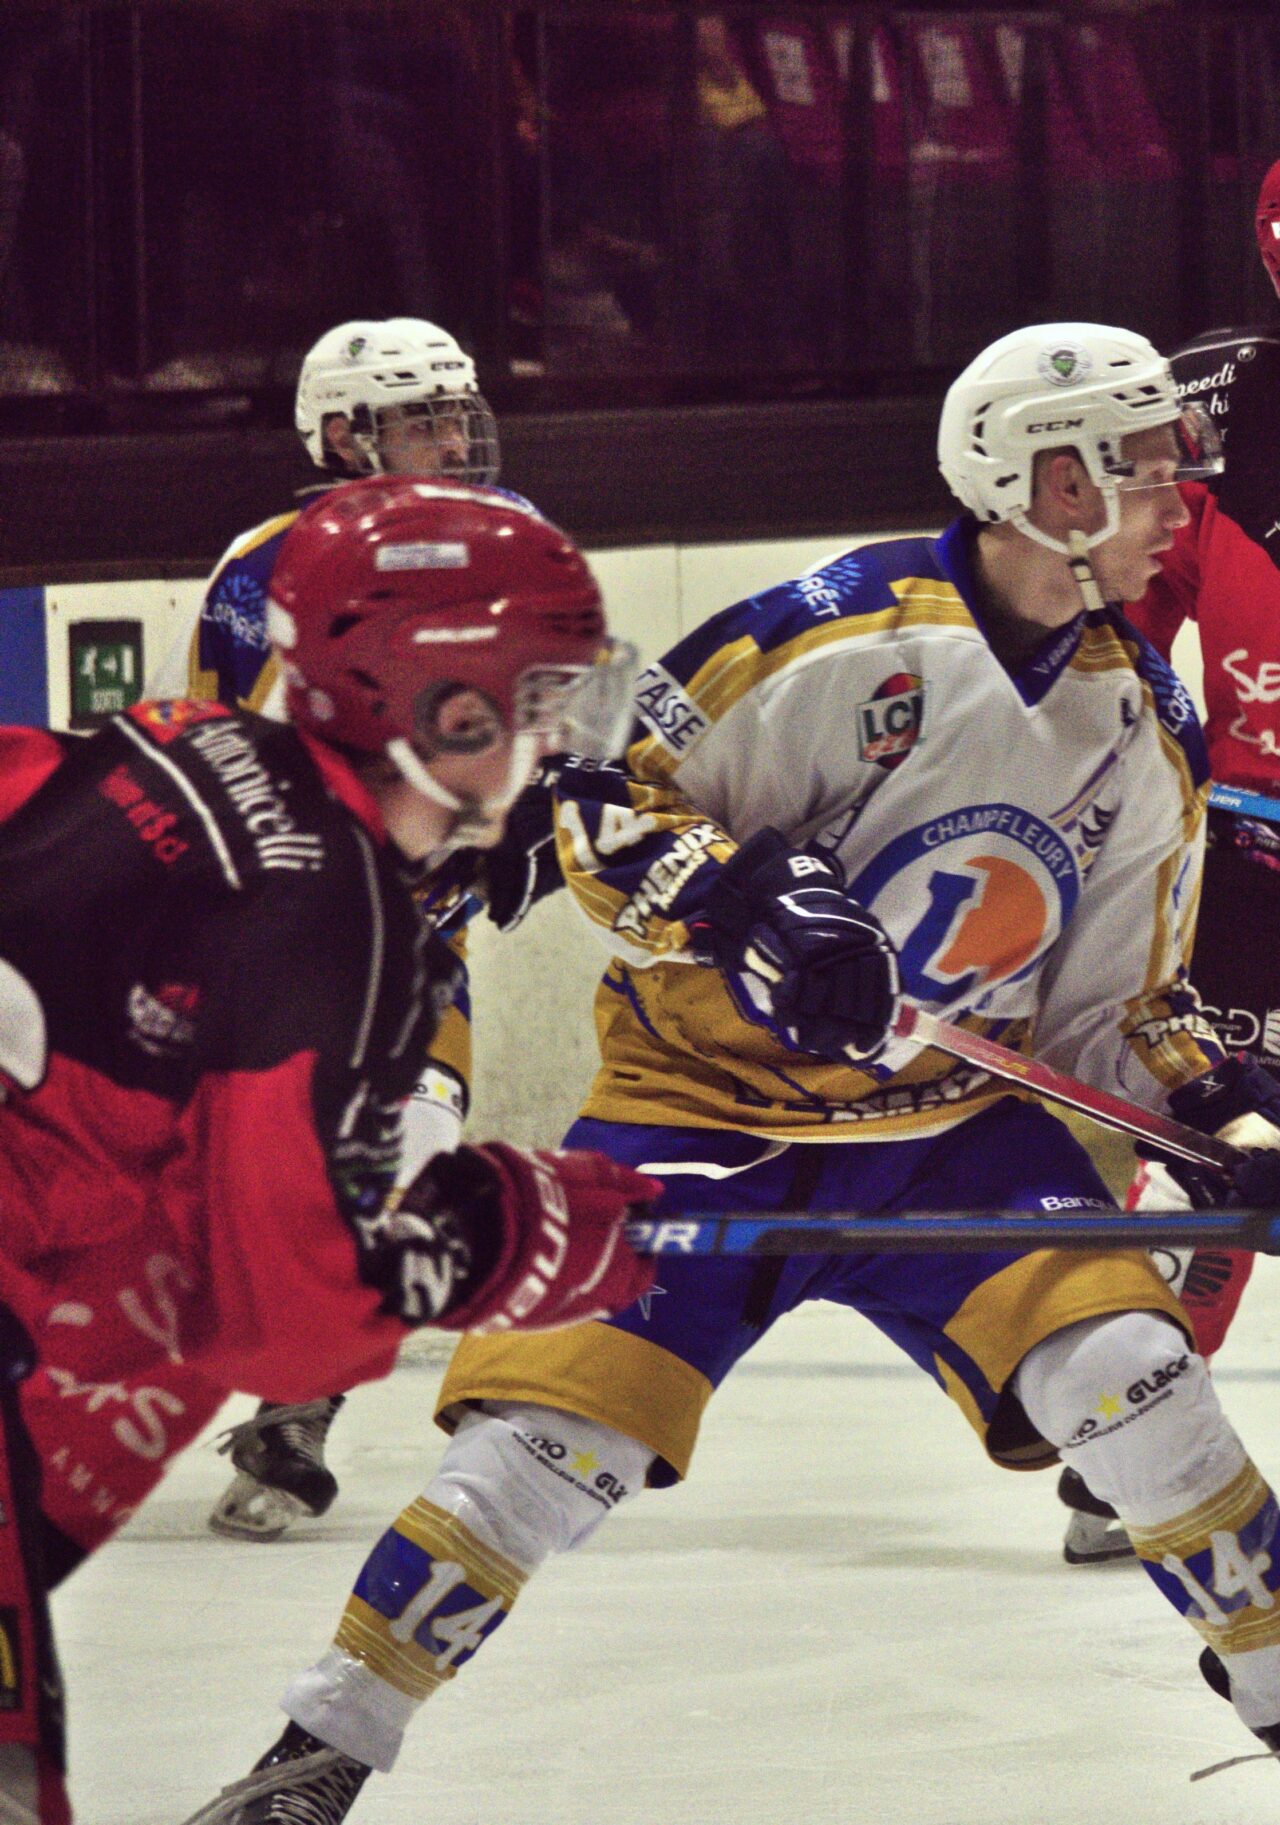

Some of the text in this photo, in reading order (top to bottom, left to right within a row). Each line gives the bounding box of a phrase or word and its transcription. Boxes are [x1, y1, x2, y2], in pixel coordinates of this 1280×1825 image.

[1177, 364, 1236, 397] peedi
[1026, 418, 1085, 434] CCM
[922, 809, 1074, 879] CHAMPFLEURY
[613, 823, 727, 938] PHENIX
[1127, 1354, 1189, 1404] Glace
[1161, 1529, 1276, 1626] 14
[388, 1560, 505, 1671] 14
